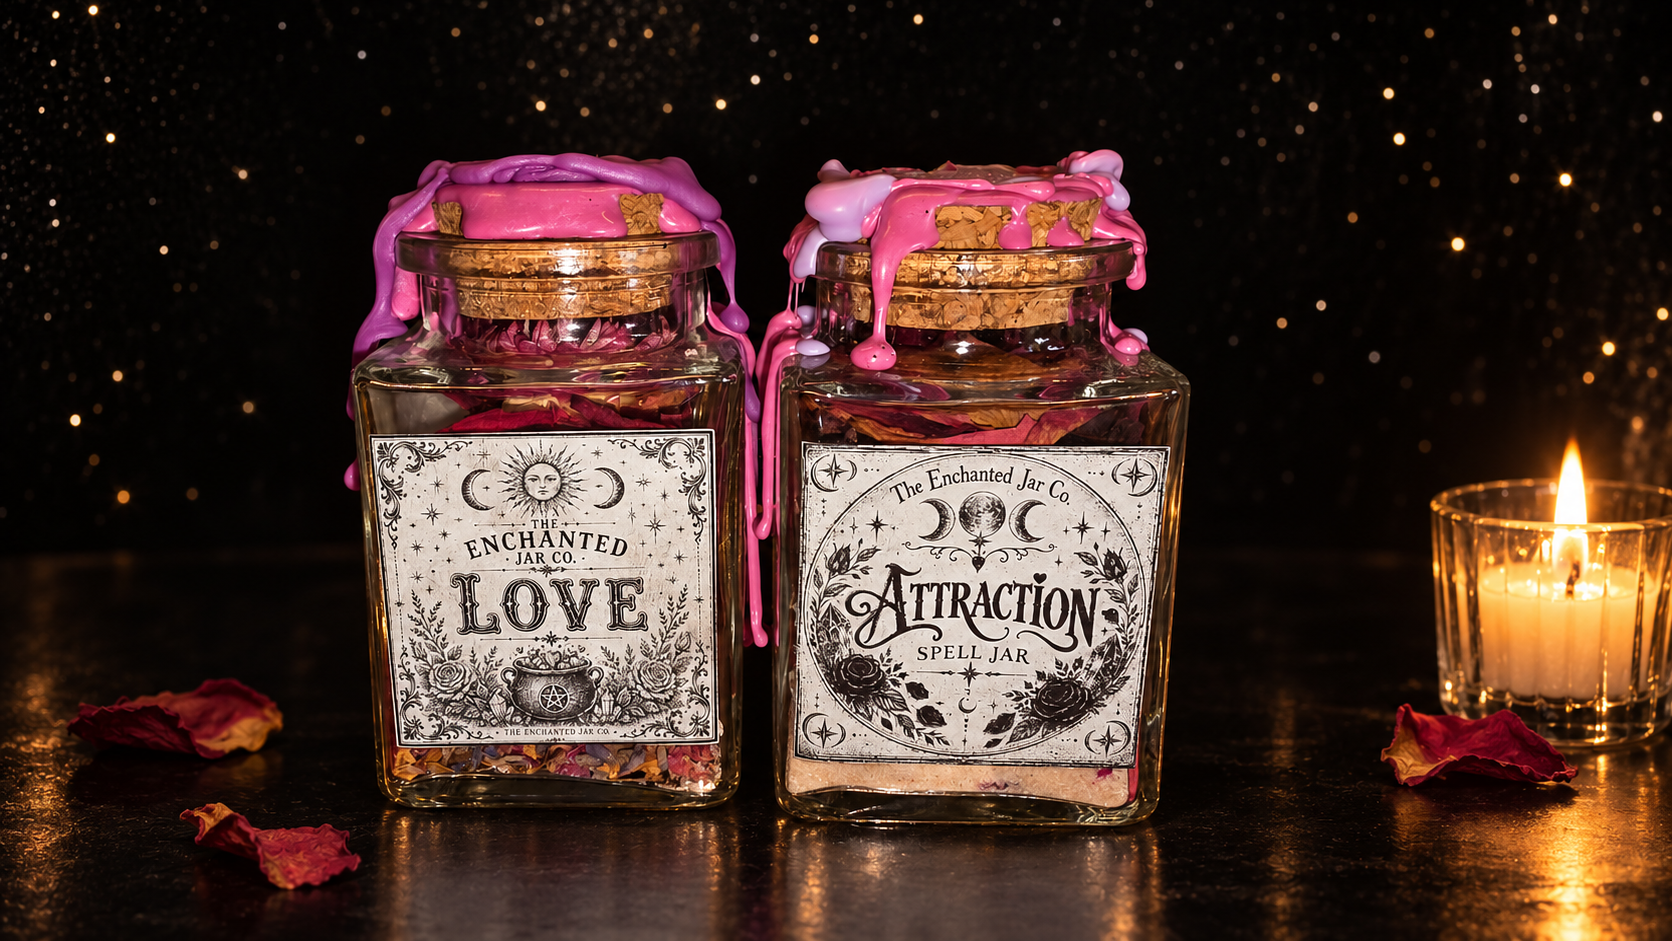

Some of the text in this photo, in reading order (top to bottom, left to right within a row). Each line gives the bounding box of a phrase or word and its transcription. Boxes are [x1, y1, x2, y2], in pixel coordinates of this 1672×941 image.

[889, 465, 1070, 506] The Enchanted Jar Co.
[531, 519, 559, 529] THE
[464, 530, 628, 560] ENCHANTED
[515, 551, 577, 565] JAR CO.
[450, 573, 649, 635] LOVE
[917, 645, 1030, 664] SPELL JAR
[504, 728, 521, 736] THE
[524, 728, 576, 736] ENCHANTED
